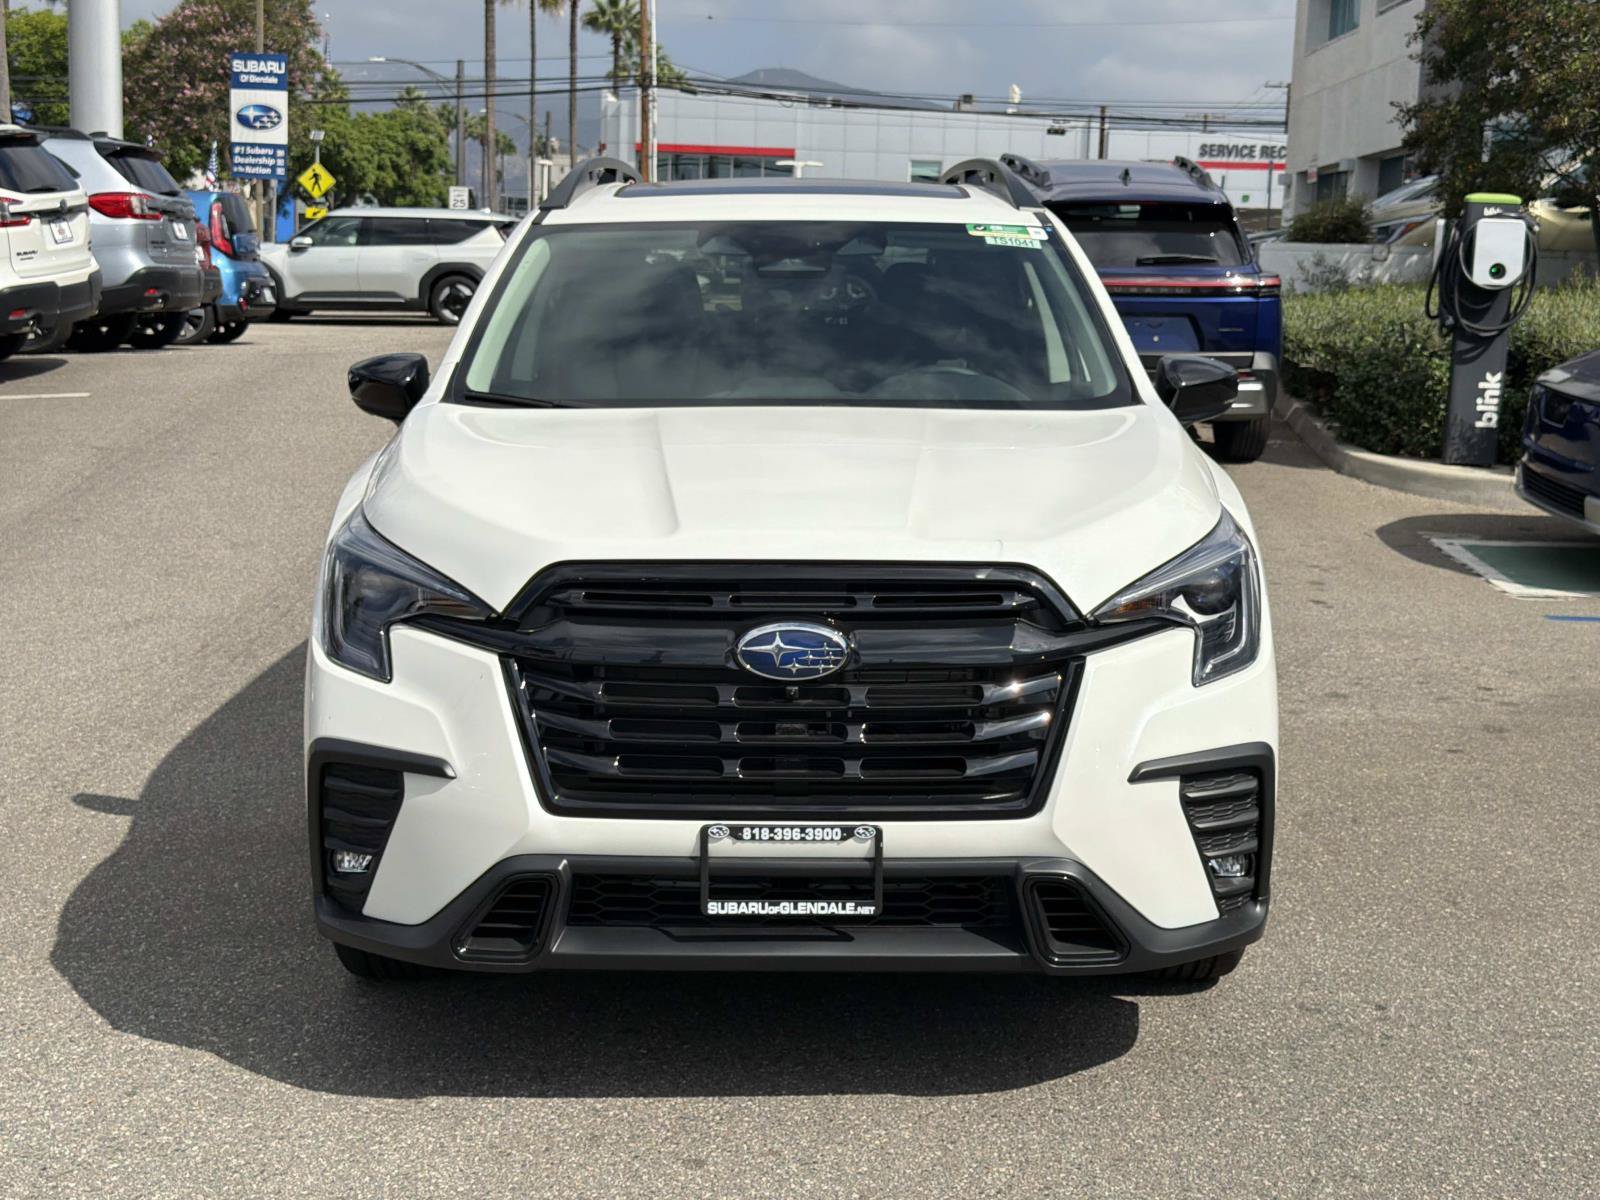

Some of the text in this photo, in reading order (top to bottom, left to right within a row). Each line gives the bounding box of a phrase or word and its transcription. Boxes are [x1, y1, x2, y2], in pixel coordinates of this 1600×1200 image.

[232, 59, 286, 74] SUBARU
[234, 145, 274, 155] #1 Subaru
[1199, 143, 1287, 159] SERVICE REC
[233, 155, 276, 166] Dealership
[245, 165, 272, 175] Nation
[452, 199, 466, 208] 25
[1474, 371, 1503, 429] blink
[742, 827, 842, 841] 818-396-3900
